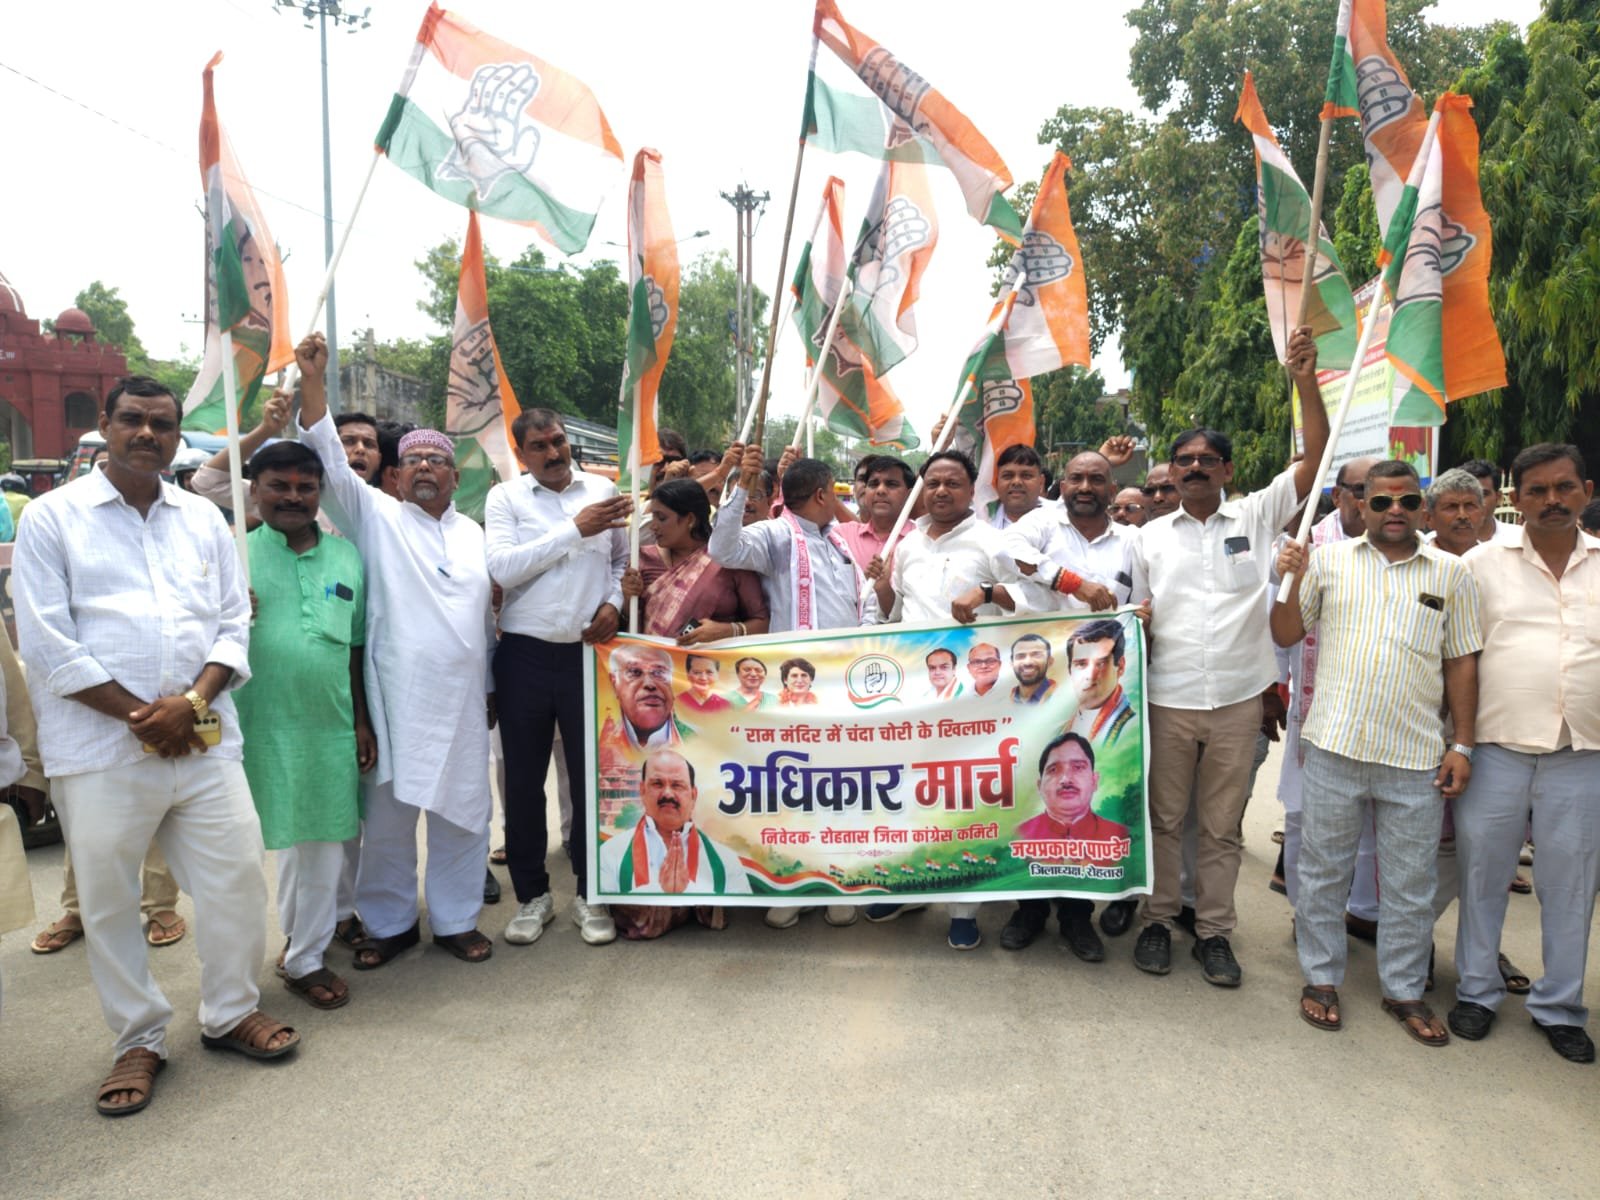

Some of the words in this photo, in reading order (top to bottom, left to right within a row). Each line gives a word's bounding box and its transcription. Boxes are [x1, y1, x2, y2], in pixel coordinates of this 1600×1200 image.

[745, 727, 776, 743] राम
[779, 724, 821, 743] मंदिर
[825, 724, 843, 743] में
[846, 724, 875, 743] चंदा
[878, 722, 912, 741] चोरी
[917, 720, 934, 739] के
[937, 717, 998, 738] खिलाफ
[718, 750, 904, 815] अधिकार
[911, 737, 1019, 811] मार्च
[819, 827, 869, 844] रोहतास
[874, 826, 908, 843] जिला
[912, 825, 953, 843] कांग्रेस
[956, 822, 998, 841] कमिटी
[1010, 840, 1084, 858] जयप्रकाश
[1084, 837, 1131, 859] पाण्डेय
[1086, 864, 1123, 879] रोहतास
